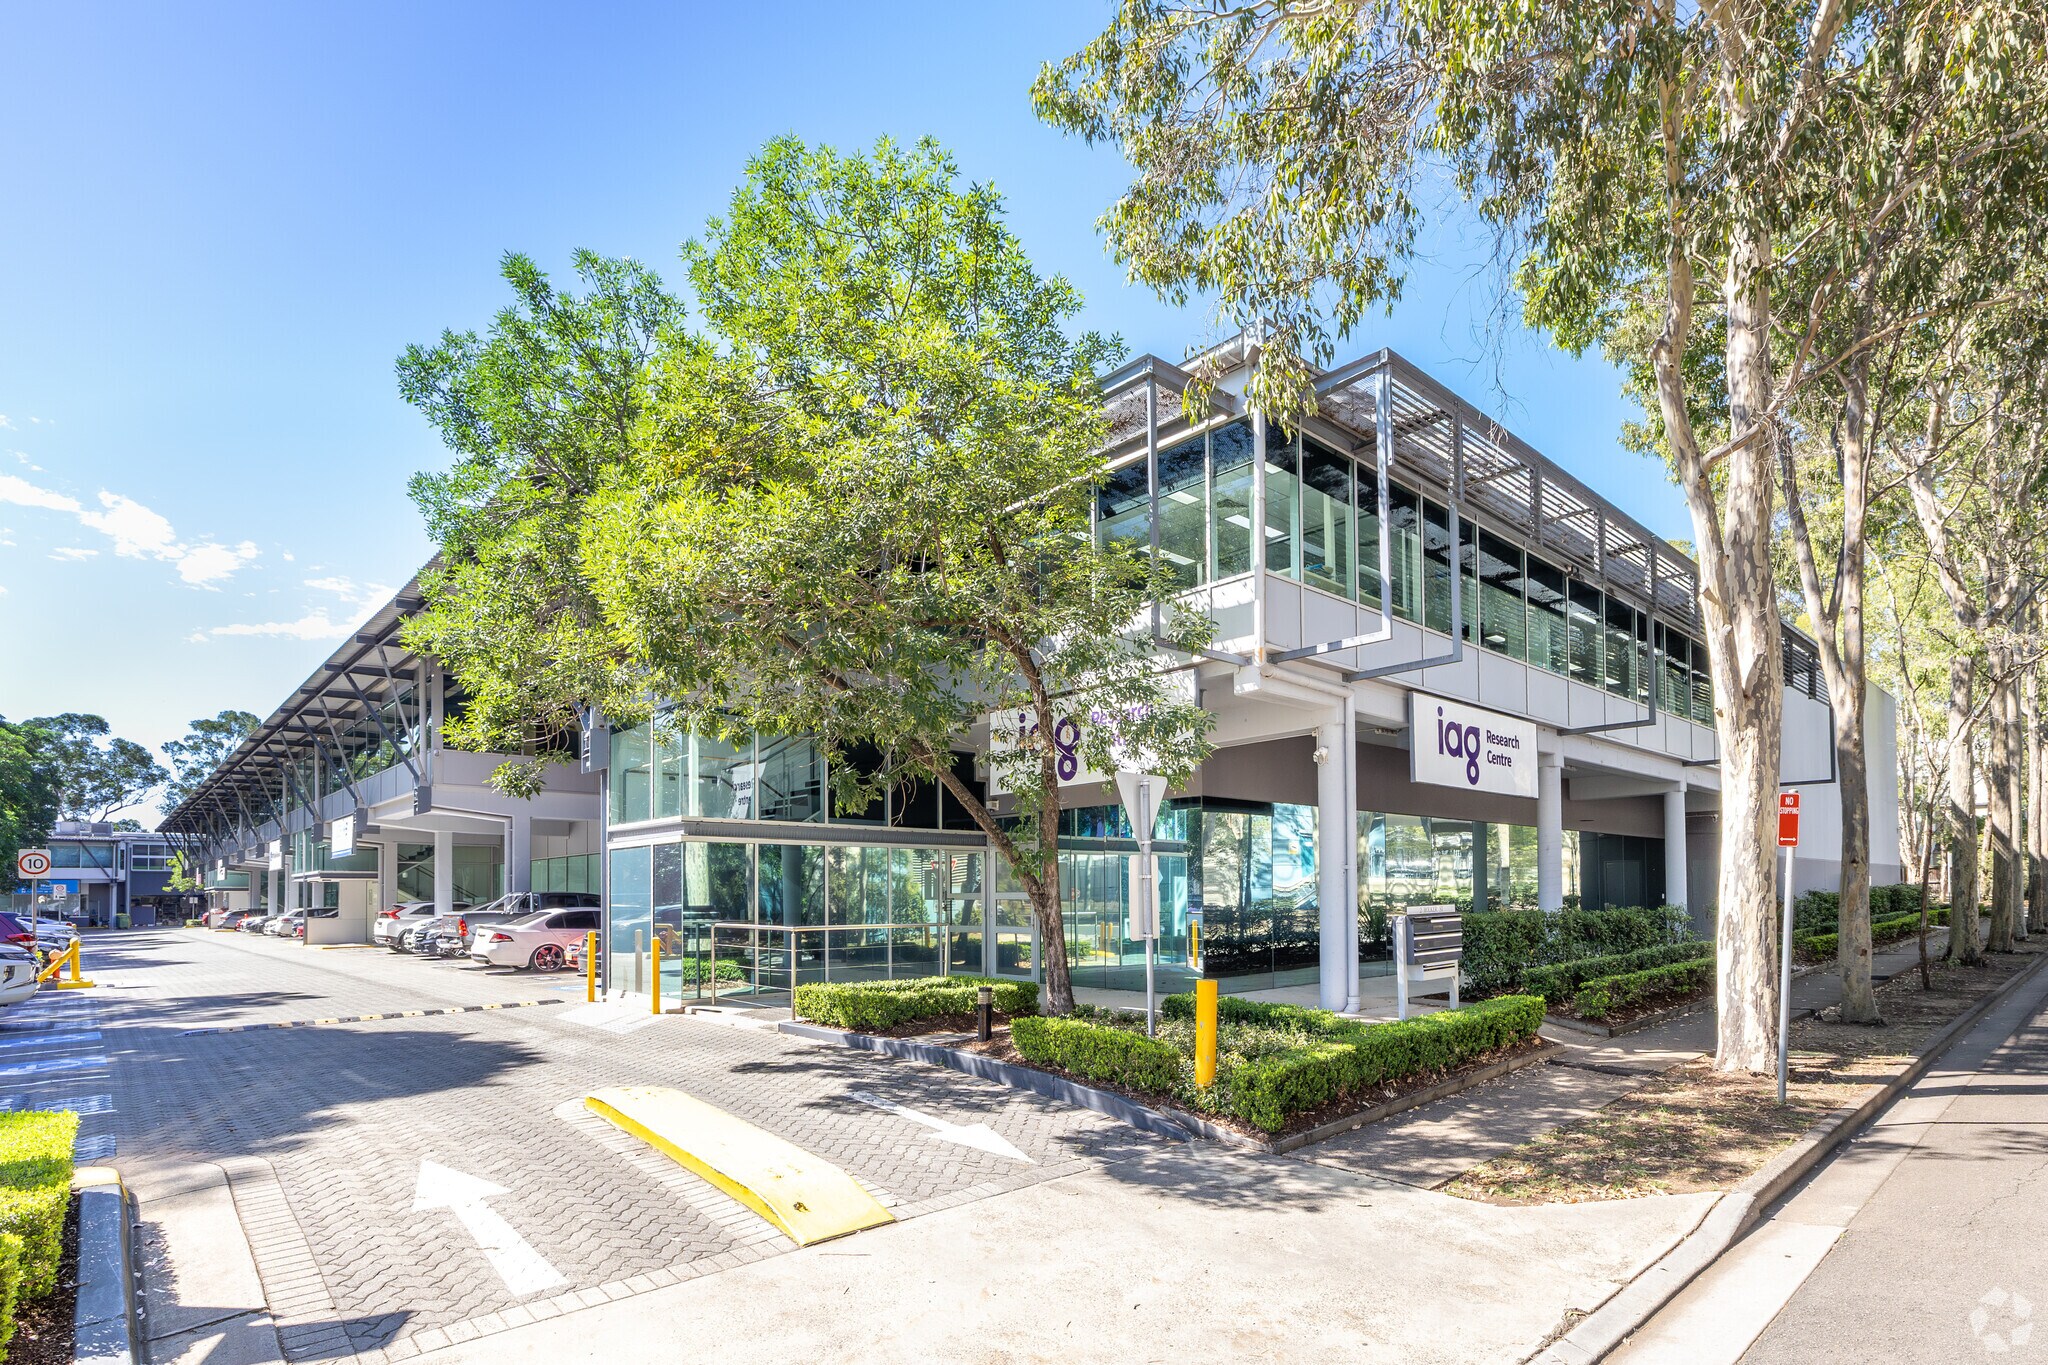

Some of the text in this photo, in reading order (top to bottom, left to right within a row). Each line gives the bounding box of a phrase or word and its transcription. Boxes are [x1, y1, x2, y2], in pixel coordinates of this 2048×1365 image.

[1019, 713, 1080, 781] ig
[1437, 706, 1481, 785] iag
[1486, 730, 1520, 749] Research
[1487, 750, 1512, 767] Centre
[1785, 796, 1794, 805] NO
[28, 859, 44, 869] 10
